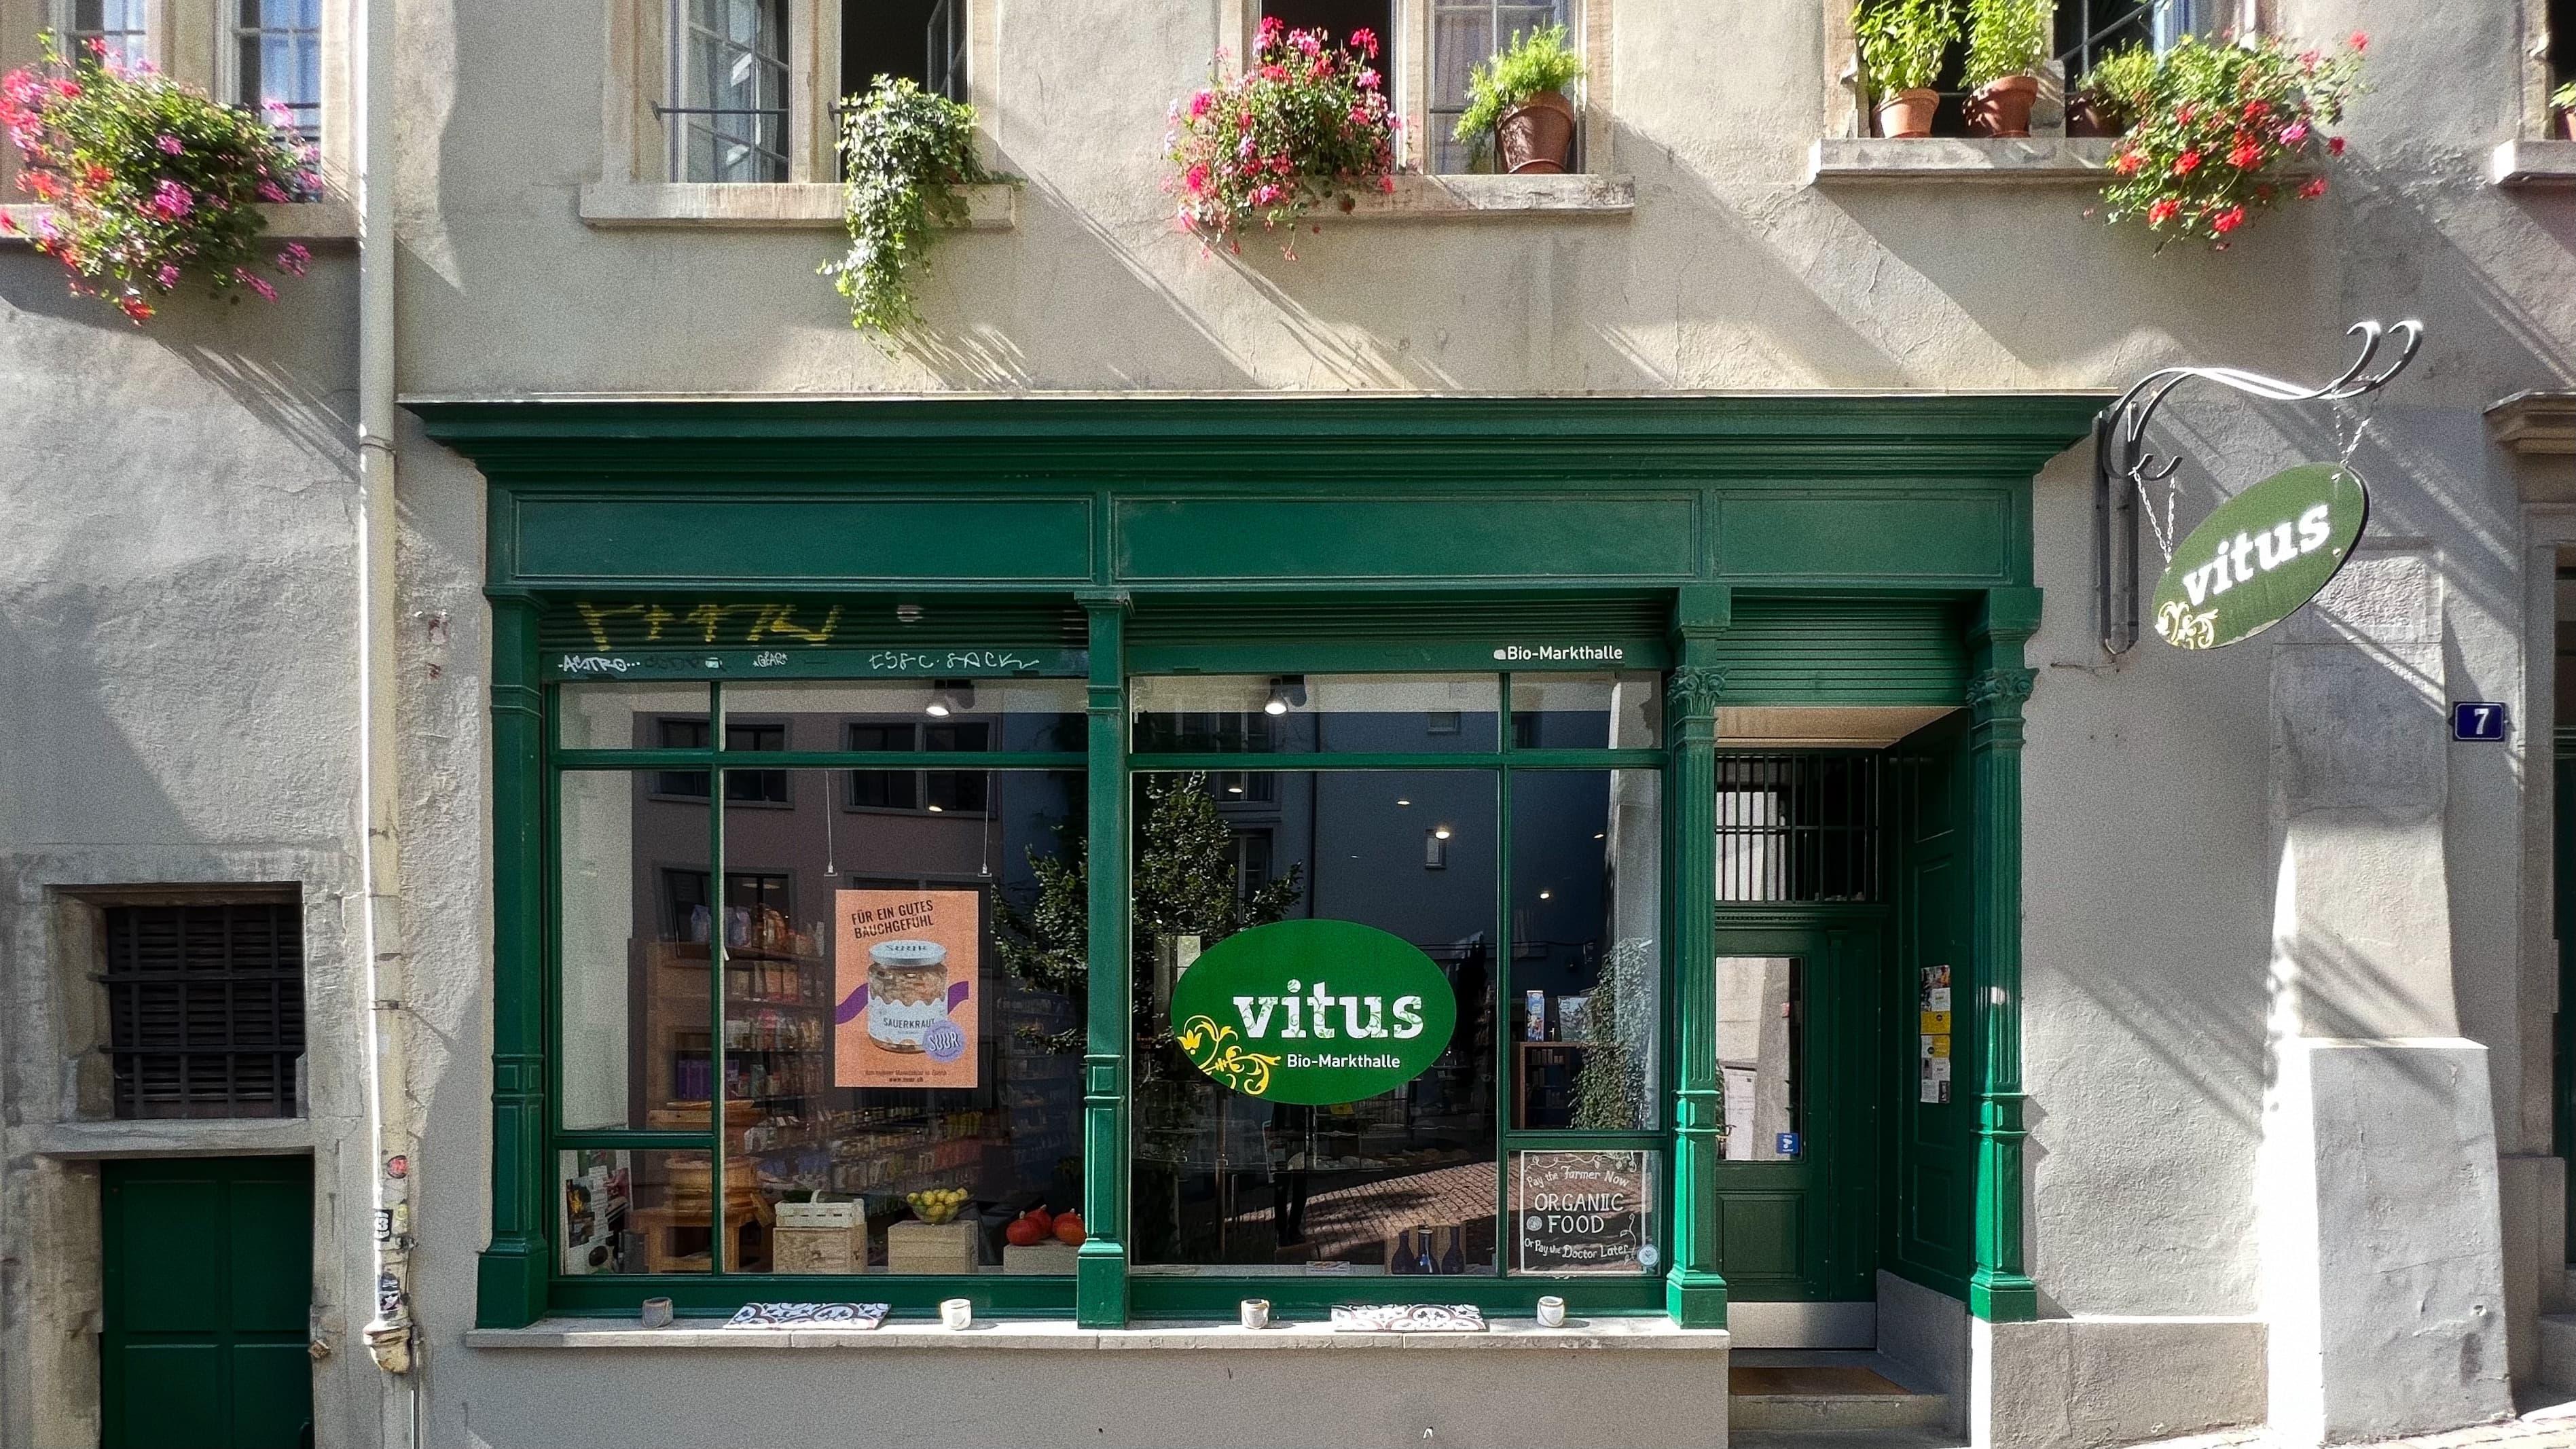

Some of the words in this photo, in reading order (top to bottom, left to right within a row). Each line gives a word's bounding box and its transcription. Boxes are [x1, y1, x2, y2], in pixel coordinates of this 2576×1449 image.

[2182, 505, 2330, 606] vitus
[1507, 646, 1622, 660] Bio-Markthalle
[2474, 709, 2489, 734] 7
[852, 909, 873, 925] FÜR
[877, 906, 894, 920] EIN
[899, 899, 933, 916] GUTES
[854, 914, 934, 939] BAUCHGEFÜHL
[1233, 979, 1424, 1039] vitus
[884, 1018, 935, 1028] SAUERKRAUT
[1286, 1054, 1400, 1069] Bio-Markthalle
[1527, 1176, 1544, 1188] Pay
[1545, 1171, 1559, 1181] the
[1561, 1165, 1600, 1180] Farmer
[1604, 1170, 1630, 1187] Now
[1547, 1215, 1605, 1234] FOOD
[1524, 1238, 1534, 1247] Or
[1535, 1240, 1548, 1256] Pay
[1562, 1245, 1597, 1259] Doctor
[1600, 1244, 1629, 1257] Later
